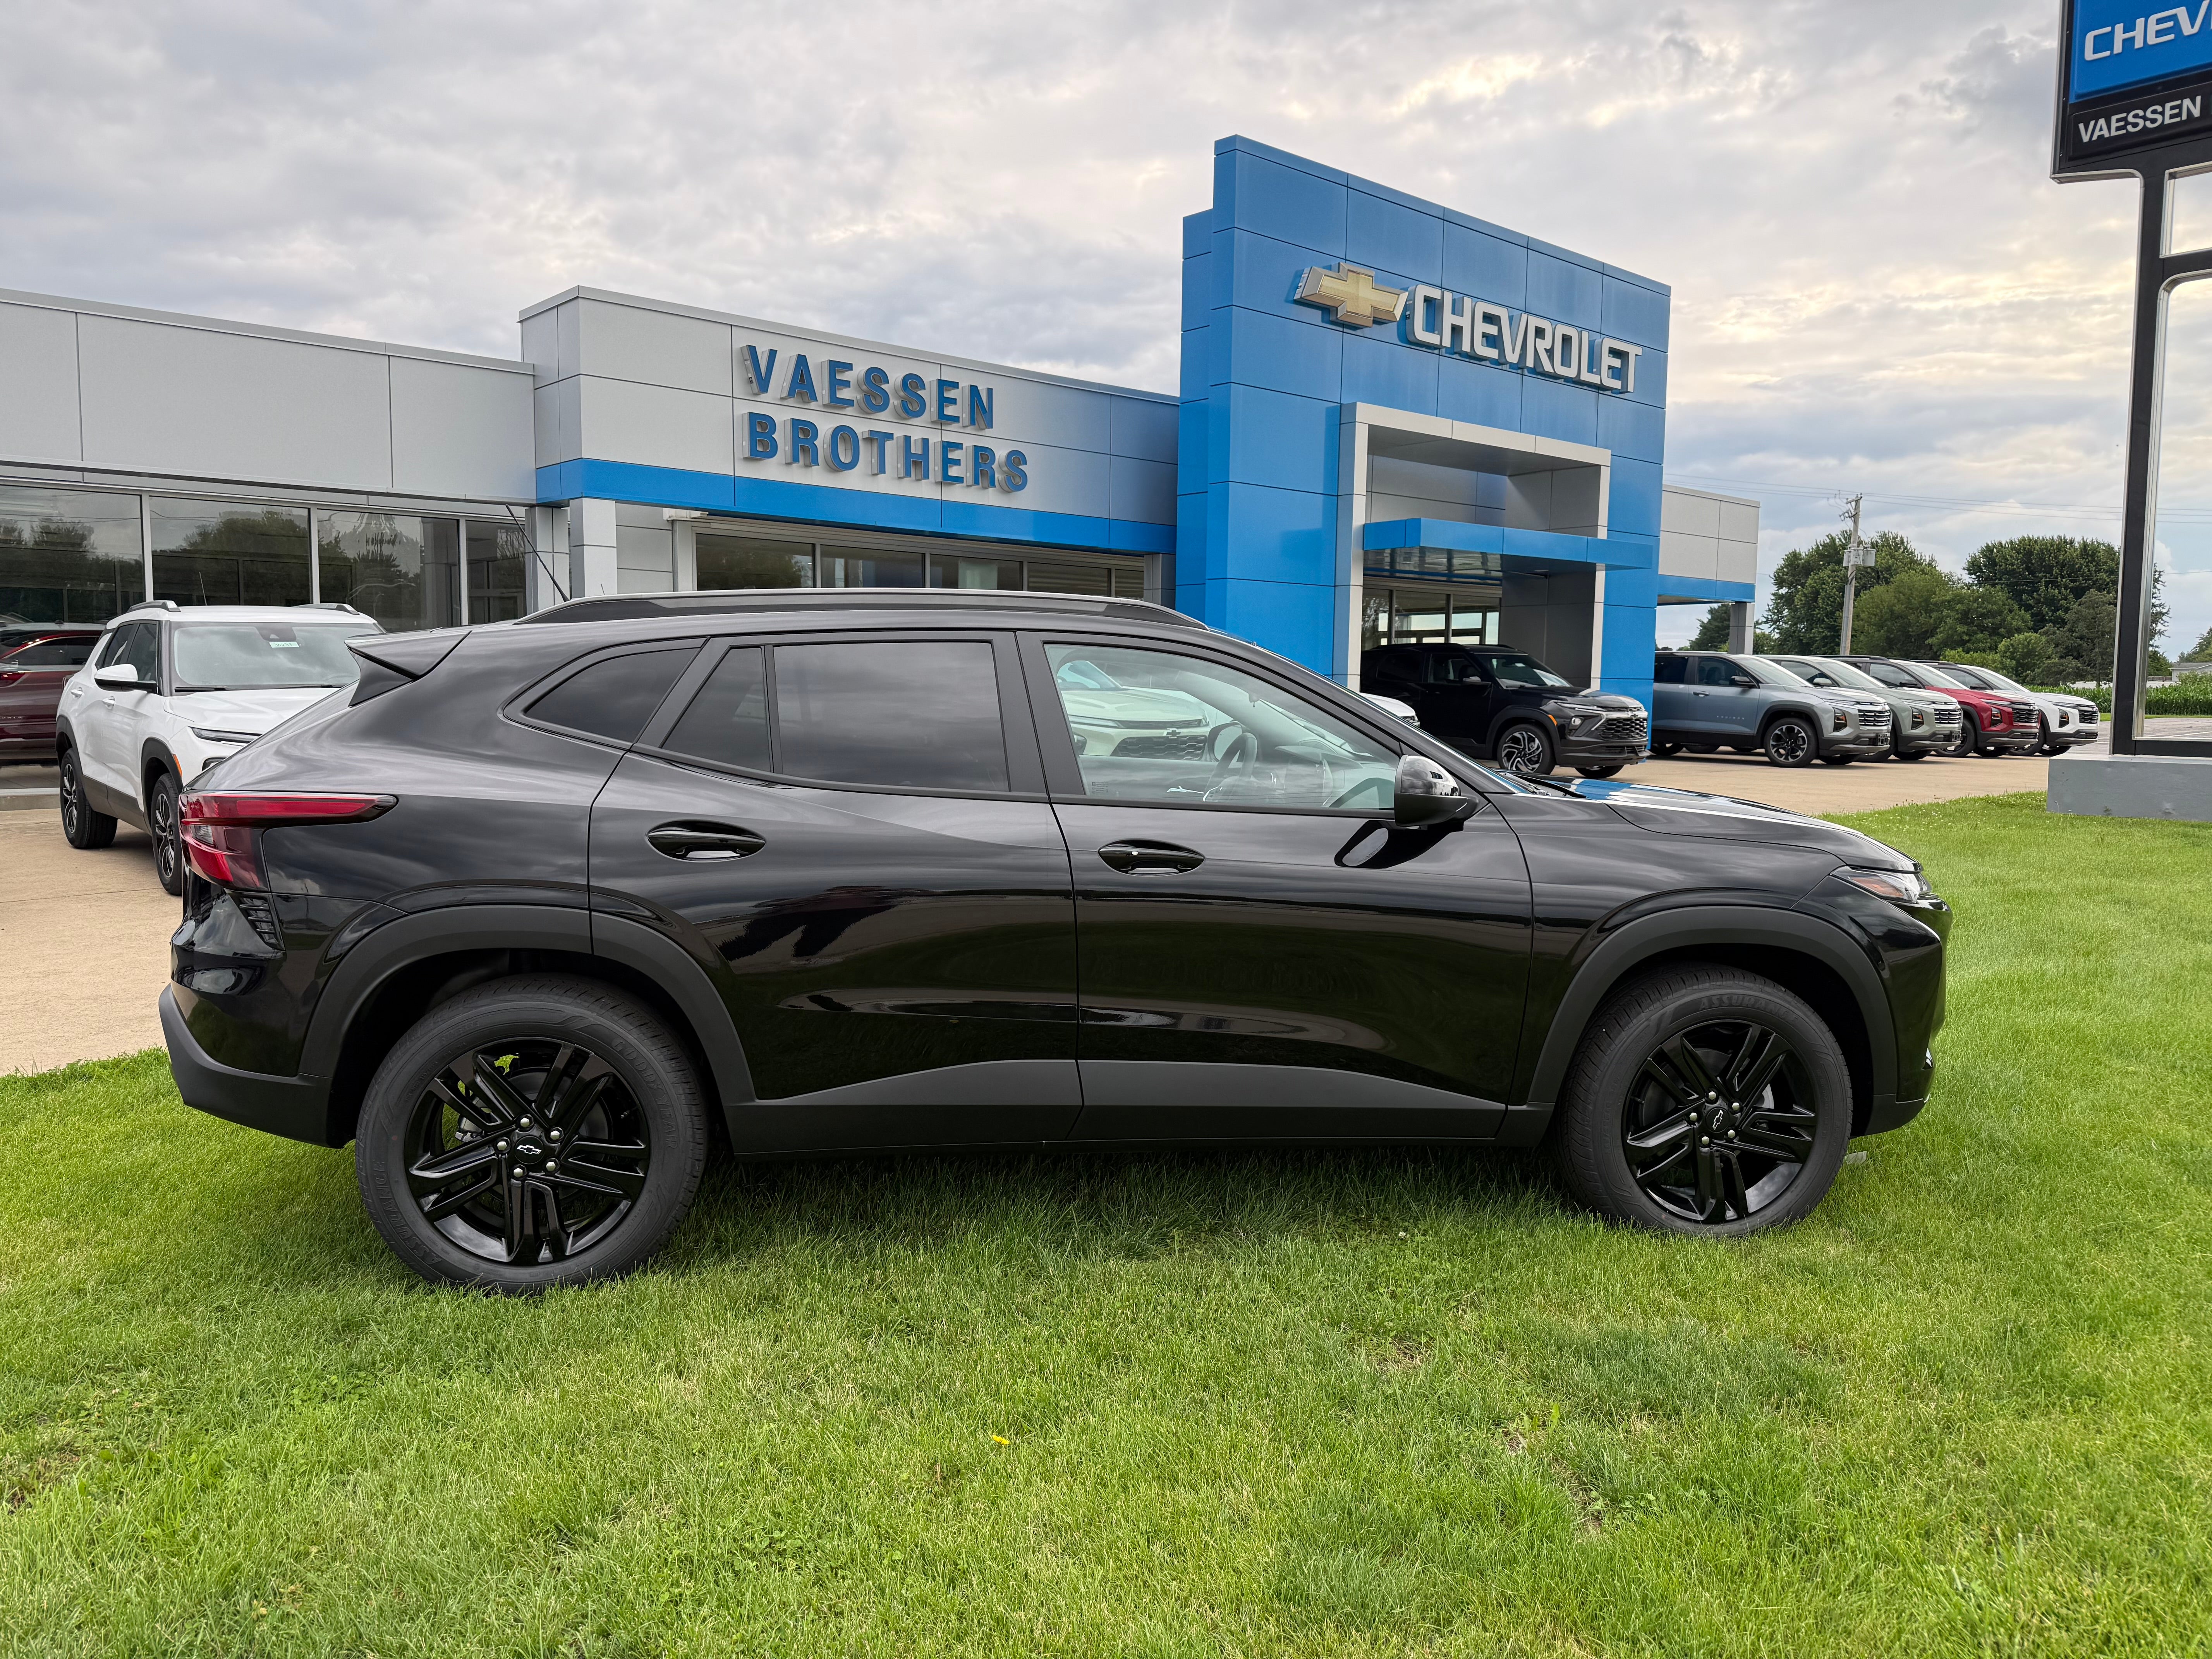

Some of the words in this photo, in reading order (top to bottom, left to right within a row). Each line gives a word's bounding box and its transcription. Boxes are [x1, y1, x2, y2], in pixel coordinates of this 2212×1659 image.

[2084, 0, 2212, 61] CHEV
[2078, 95, 2202, 143] VAESSEN
[1406, 283, 1642, 394] CHEVROLET
[741, 345, 993, 429] VAESSEN
[742, 411, 1028, 493] BROTHERS
